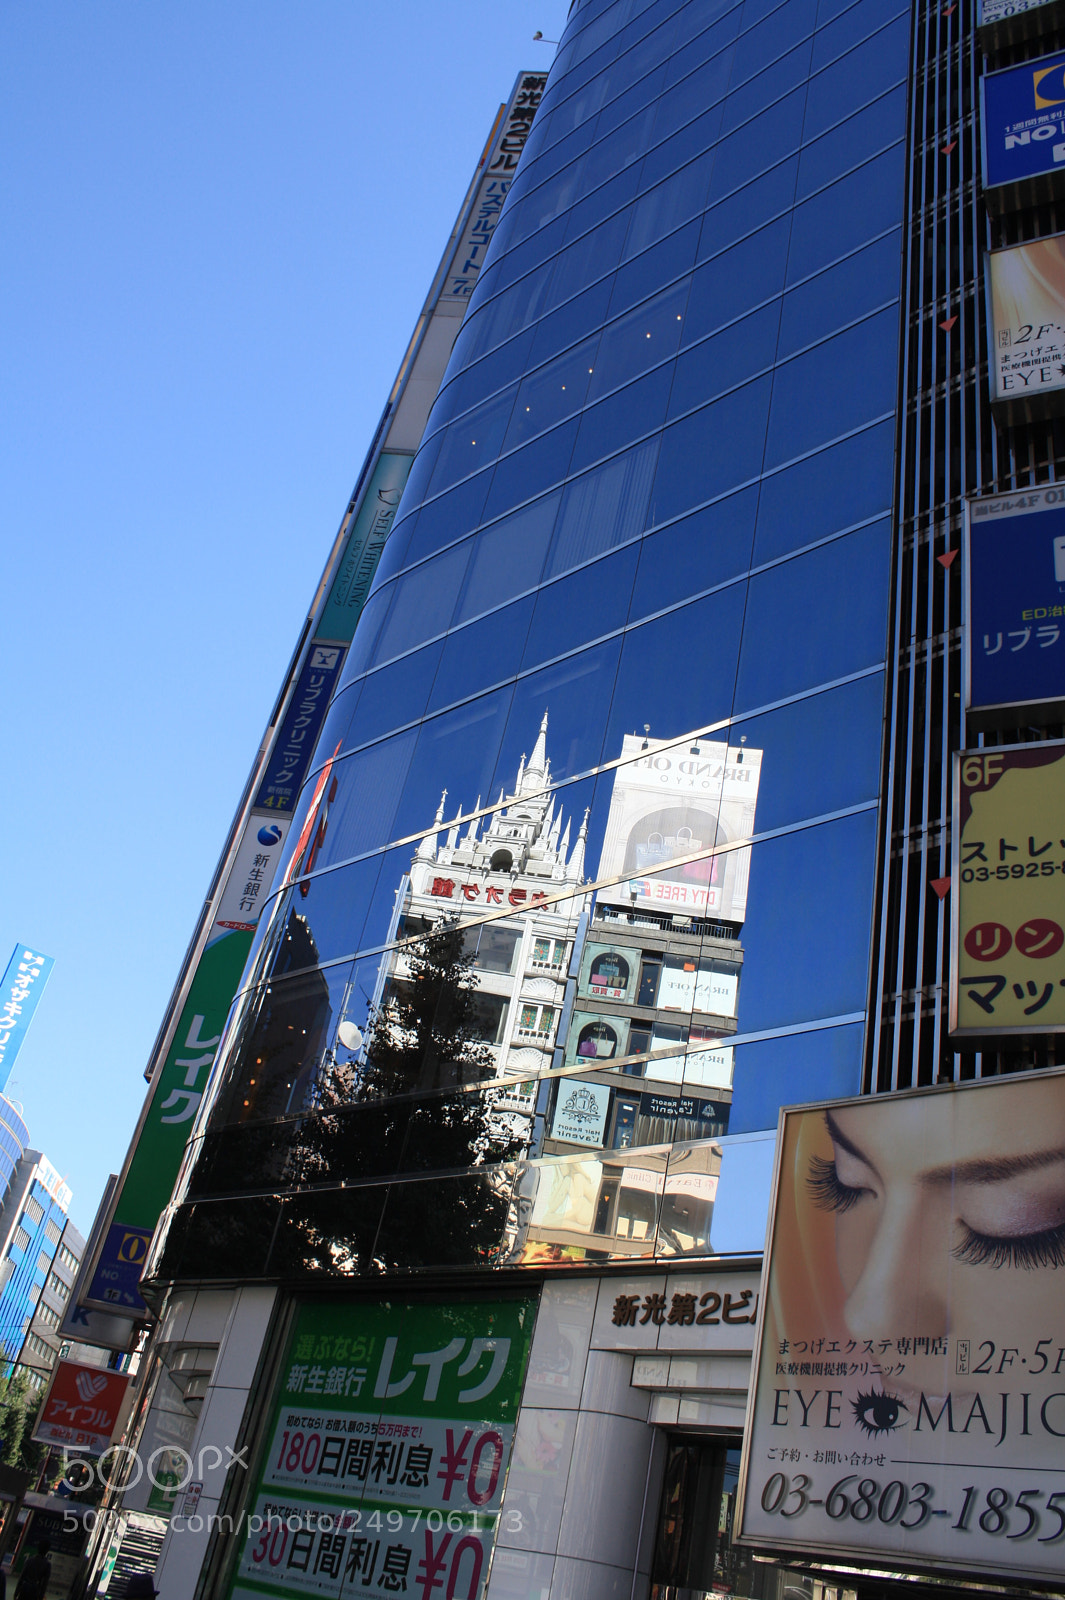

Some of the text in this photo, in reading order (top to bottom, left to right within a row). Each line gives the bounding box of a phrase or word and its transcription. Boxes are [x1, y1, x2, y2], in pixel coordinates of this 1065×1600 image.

[490, 75, 547, 170] 新光第2ビル
[1004, 110, 1065, 133] 1週間無利
[1005, 125, 1057, 150] NO
[462, 181, 511, 274] パステルコート
[452, 280, 472, 294] 7F
[1000, 344, 1065, 363] まつげエ
[1001, 351, 1065, 372] 医療機関提携
[1002, 366, 1052, 391] EYE
[348, 510, 395, 608] SELF WHITENING
[1022, 604, 1065, 621] ED治
[983, 624, 1060, 656] リブラ
[275, 674, 323, 784] リブラクリニック
[961, 754, 1004, 787] 6F
[264, 796, 290, 809] 4F
[961, 835, 1065, 864] ストレ
[239, 853, 270, 913] 新生銀行
[961, 861, 1065, 883] 03-5925-
[160, 1014, 221, 1124] レイク
[295, 1333, 376, 1362] 選ぶなら!
[778, 1336, 949, 1356] まつげエクステ専門店
[285, 1363, 368, 1397] 新生銀行
[373, 1336, 512, 1403] レイク
[775, 1361, 906, 1377] 医療機関提携クリニック
[49, 1398, 111, 1429] アイフル
[771, 1388, 843, 1429] EYE
[76, 1433, 98, 1446] B1F
[276, 1430, 434, 1488] 180日間利息
[436, 1428, 504, 1506] ¥0
[767, 1447, 887, 1467] ご予約・お問い合わせ
[760, 1471, 1065, 1542] 03-6803-1855
[252, 1519, 413, 1593] 30日間利息
